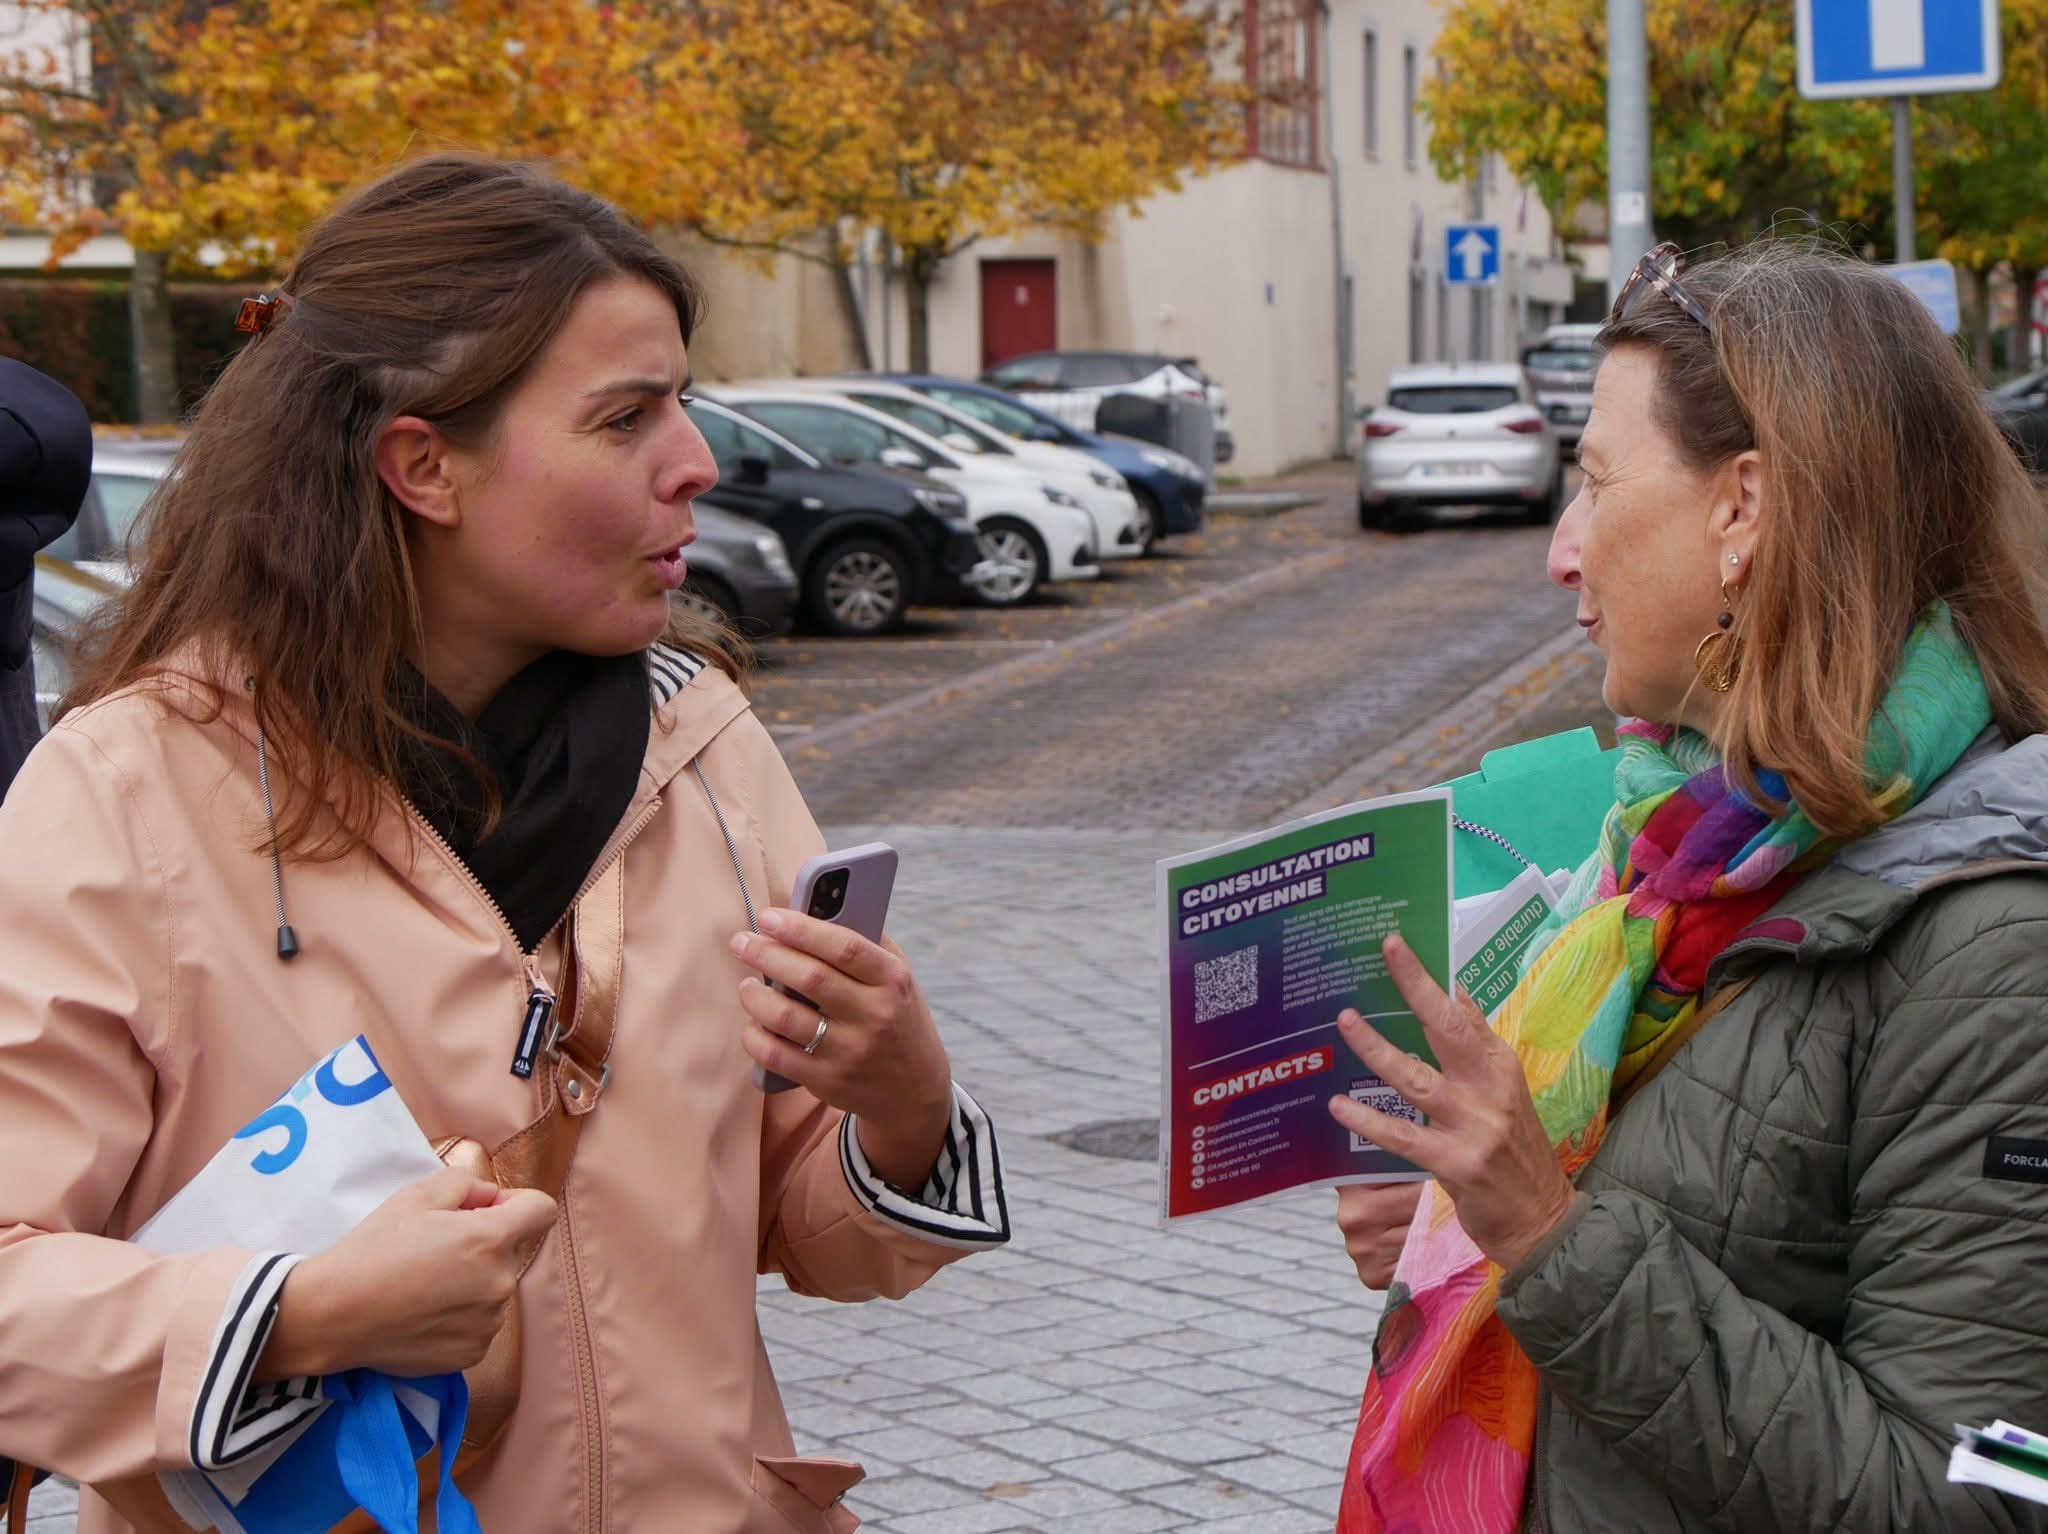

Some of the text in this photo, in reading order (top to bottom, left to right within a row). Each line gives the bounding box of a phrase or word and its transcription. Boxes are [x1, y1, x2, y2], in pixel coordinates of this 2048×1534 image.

[1182, 836, 1370, 909] CONSULTATION
[1182, 877, 1323, 936] CITOYENNE
[1458, 900, 1543, 991] durable et sol
[1487, 970, 1512, 999] une
[1193, 1052, 1324, 1107] CONTACTS
[2003, 1153, 2048, 1168] FORCLA
